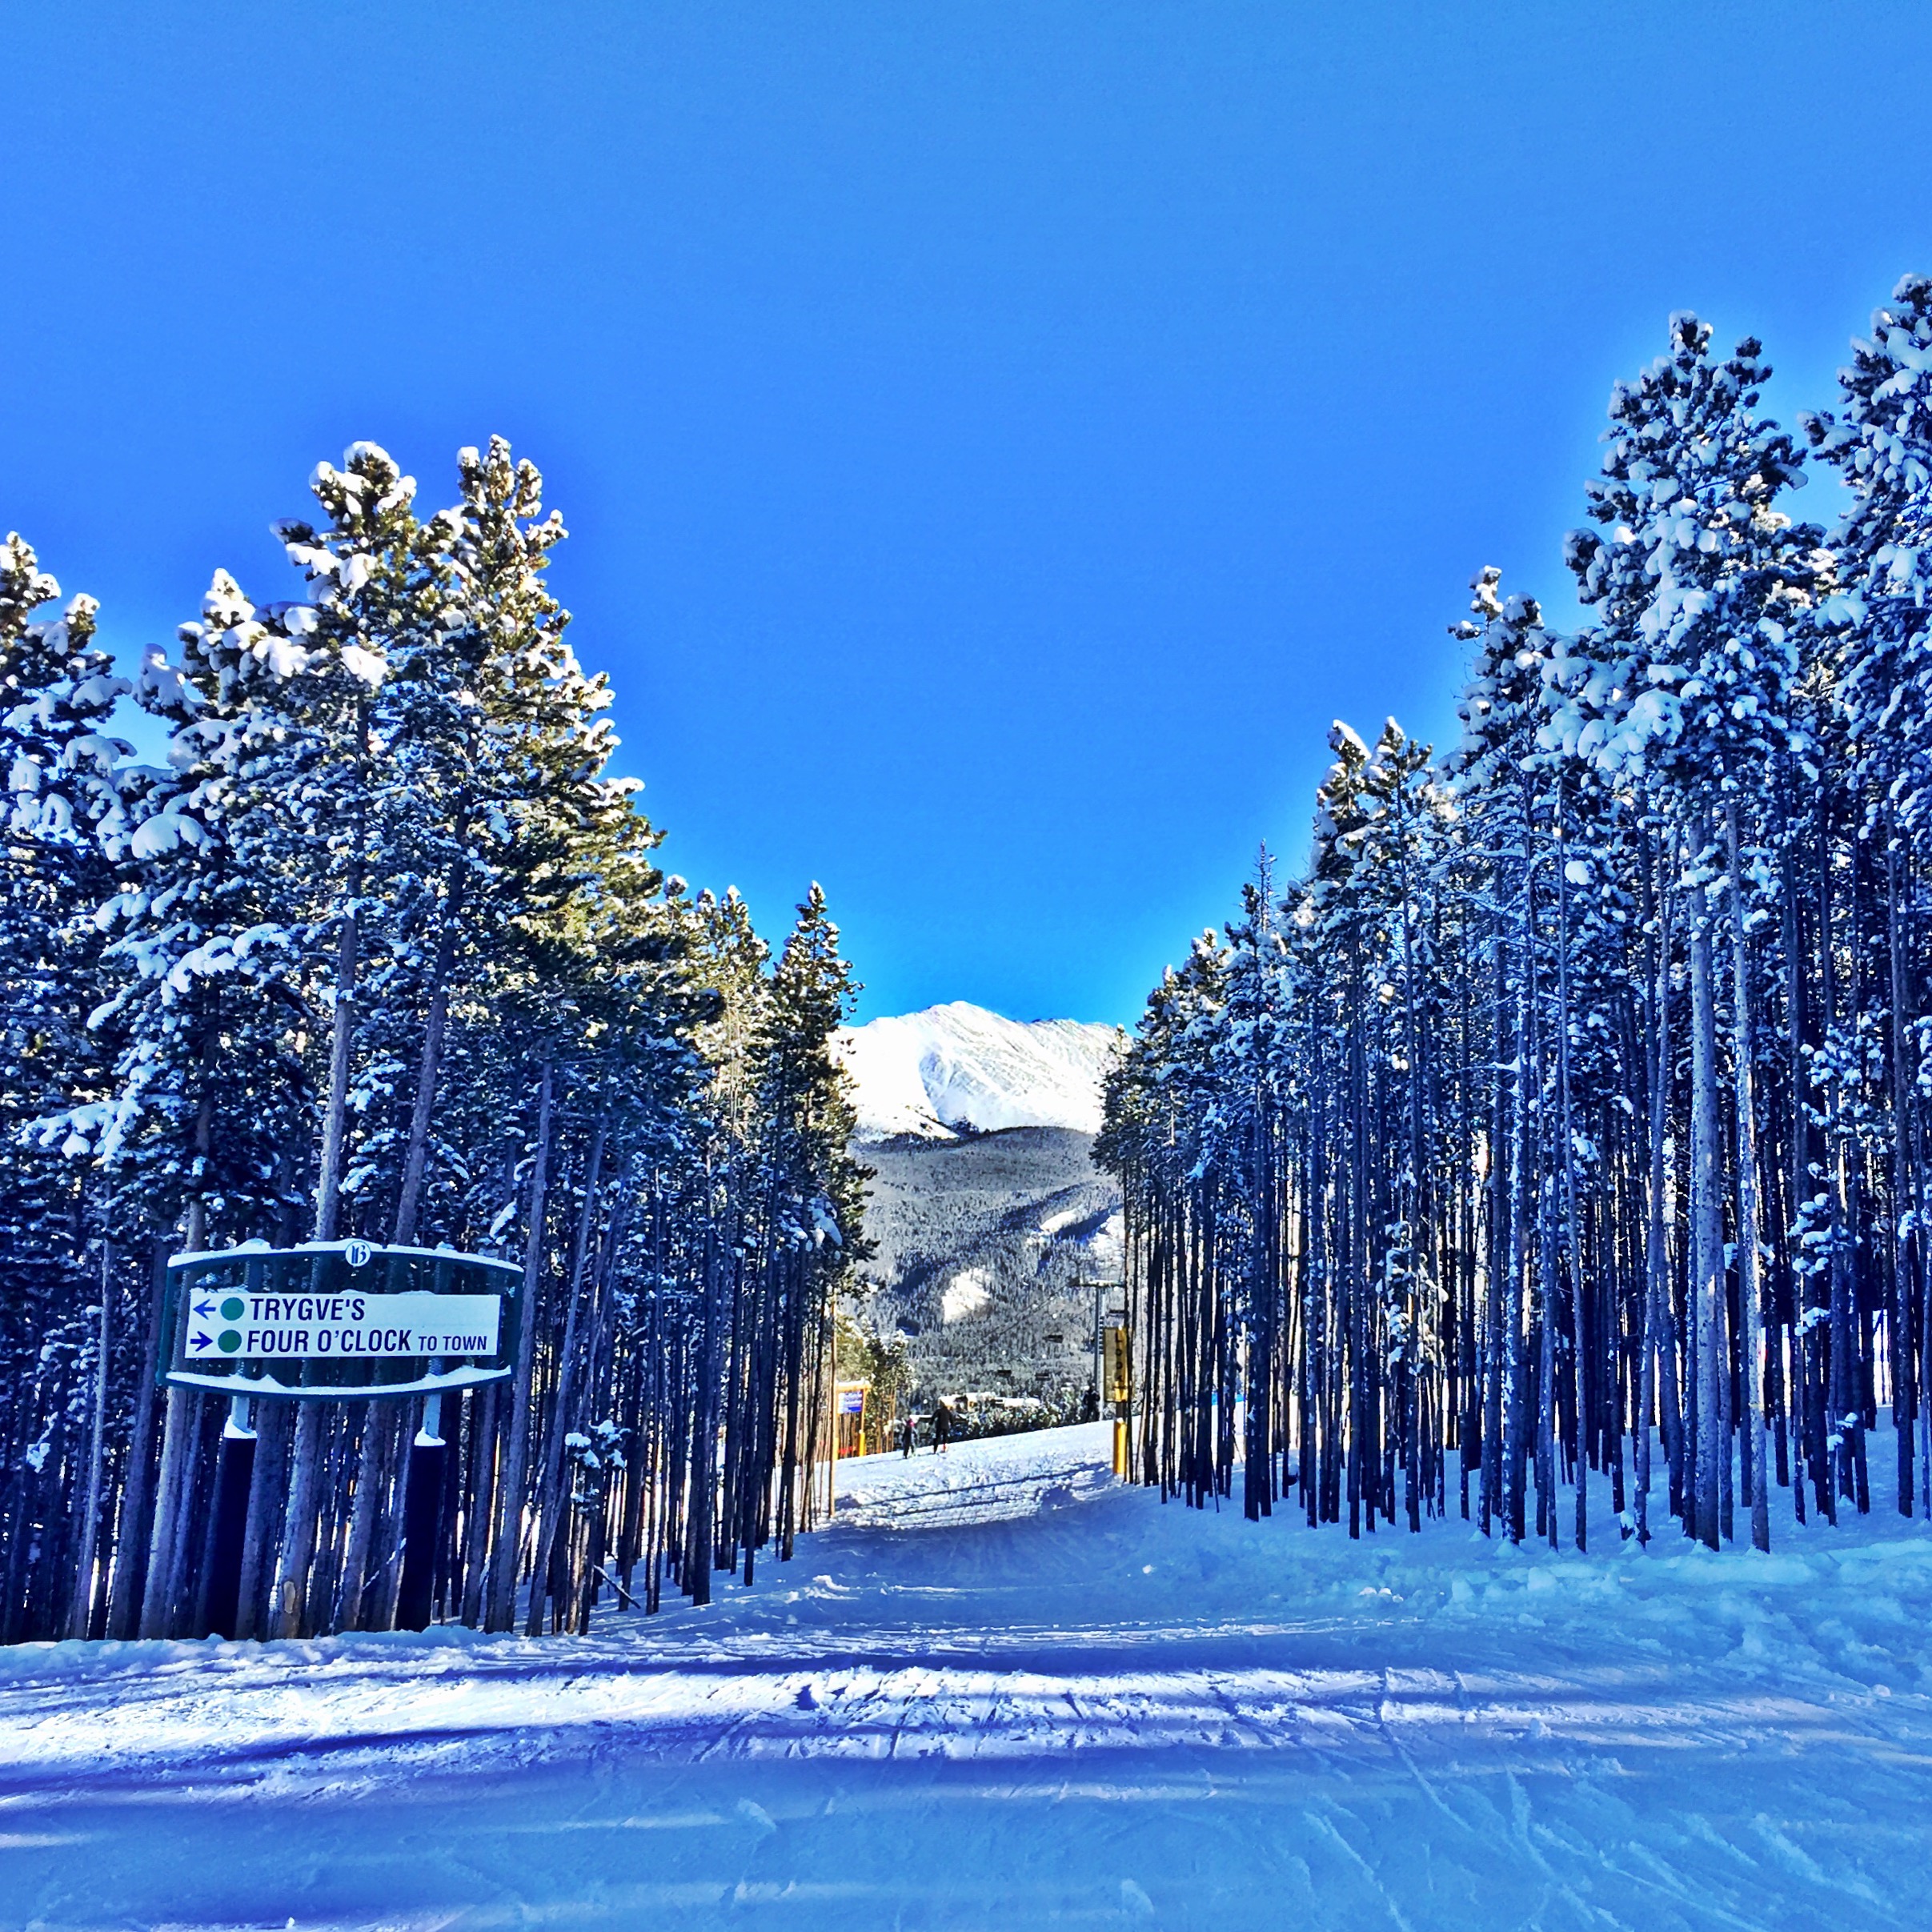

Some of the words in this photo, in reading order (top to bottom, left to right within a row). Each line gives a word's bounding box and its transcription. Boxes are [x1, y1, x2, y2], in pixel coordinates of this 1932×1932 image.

[250, 1298, 366, 1321] TRYGVE'S
[247, 1329, 309, 1353] FOUR
[317, 1329, 412, 1353] O'CLOCK
[418, 1335, 438, 1352] TO
[443, 1335, 487, 1351] TOWN
